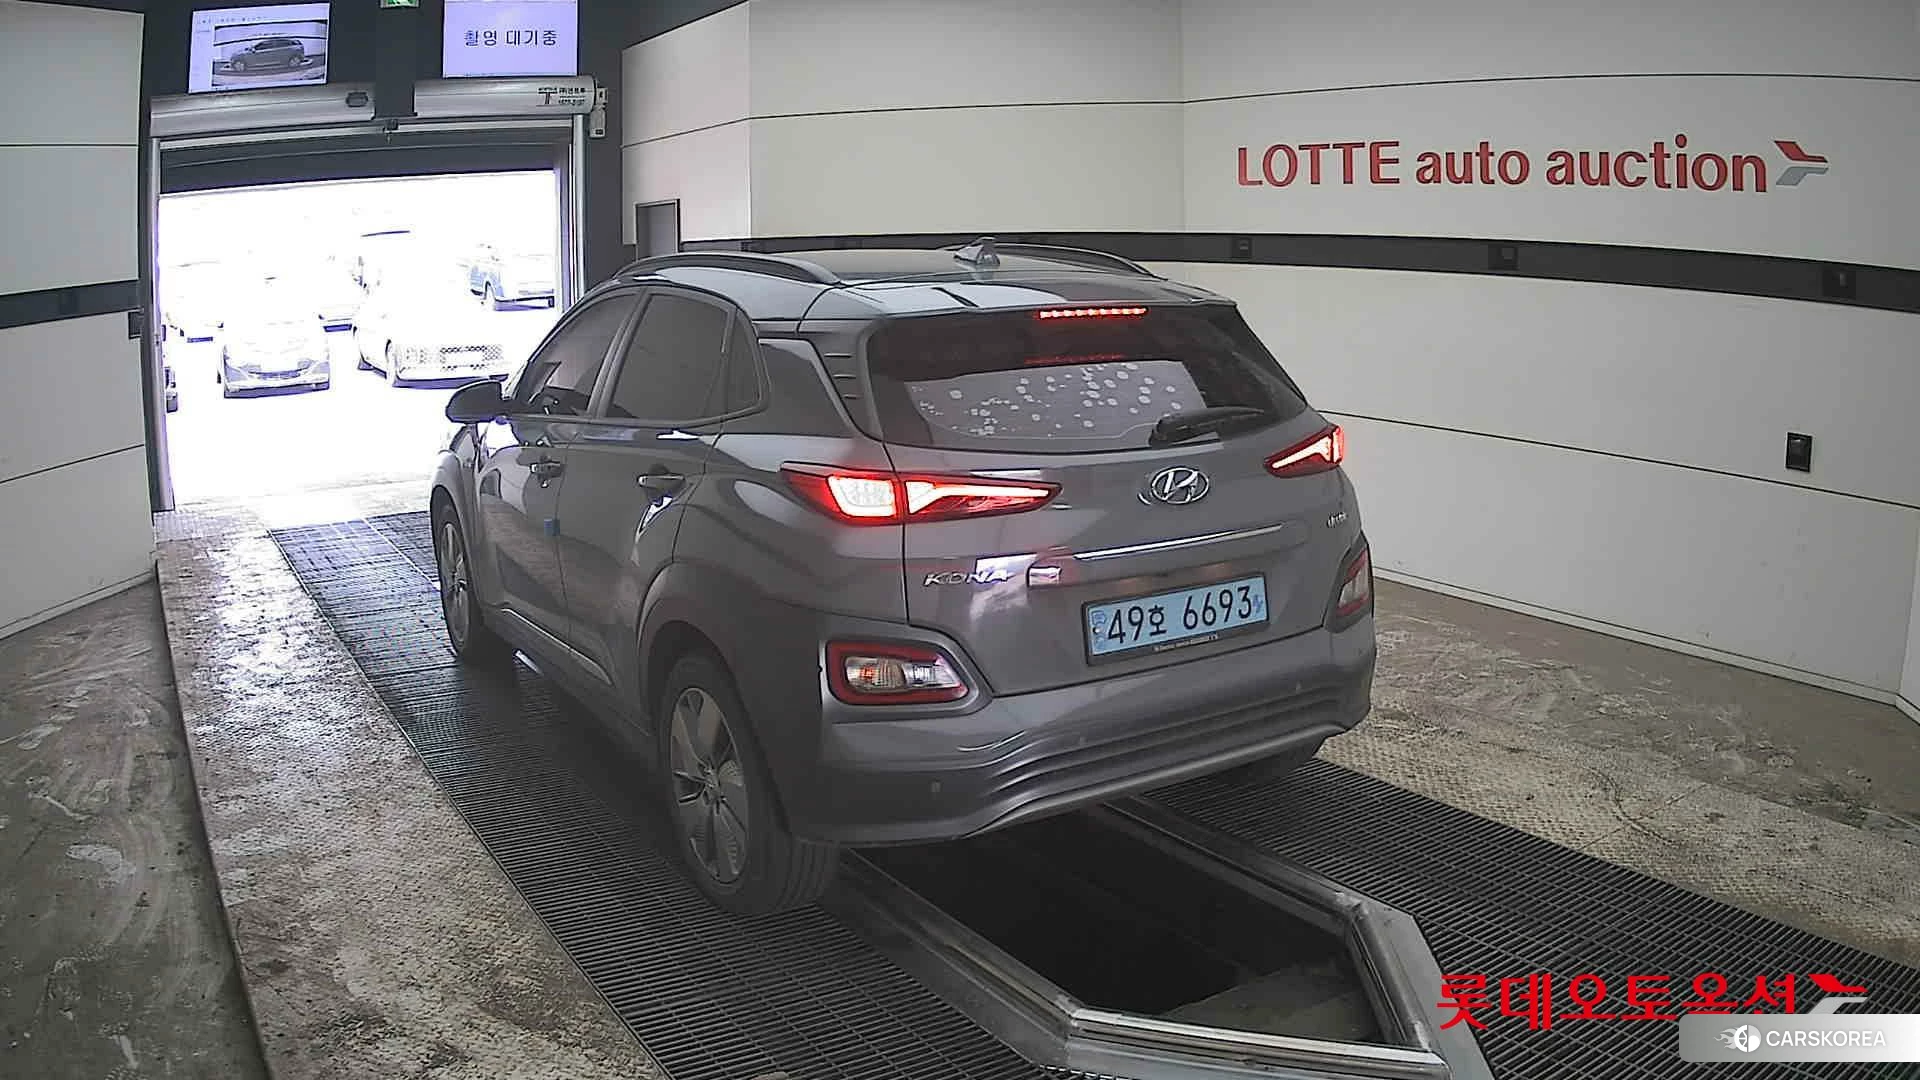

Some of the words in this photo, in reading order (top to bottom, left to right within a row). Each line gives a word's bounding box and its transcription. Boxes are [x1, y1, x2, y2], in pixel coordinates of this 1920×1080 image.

[505, 30, 558, 46] 대기중
[1237, 140, 1401, 187] LOTTE
[1415, 141, 1531, 185] auto
[1545, 133, 1768, 193] auction
[923, 567, 1015, 588] KONA
[1107, 604, 1168, 645] 49호
[1182, 585, 1252, 631] 6693
